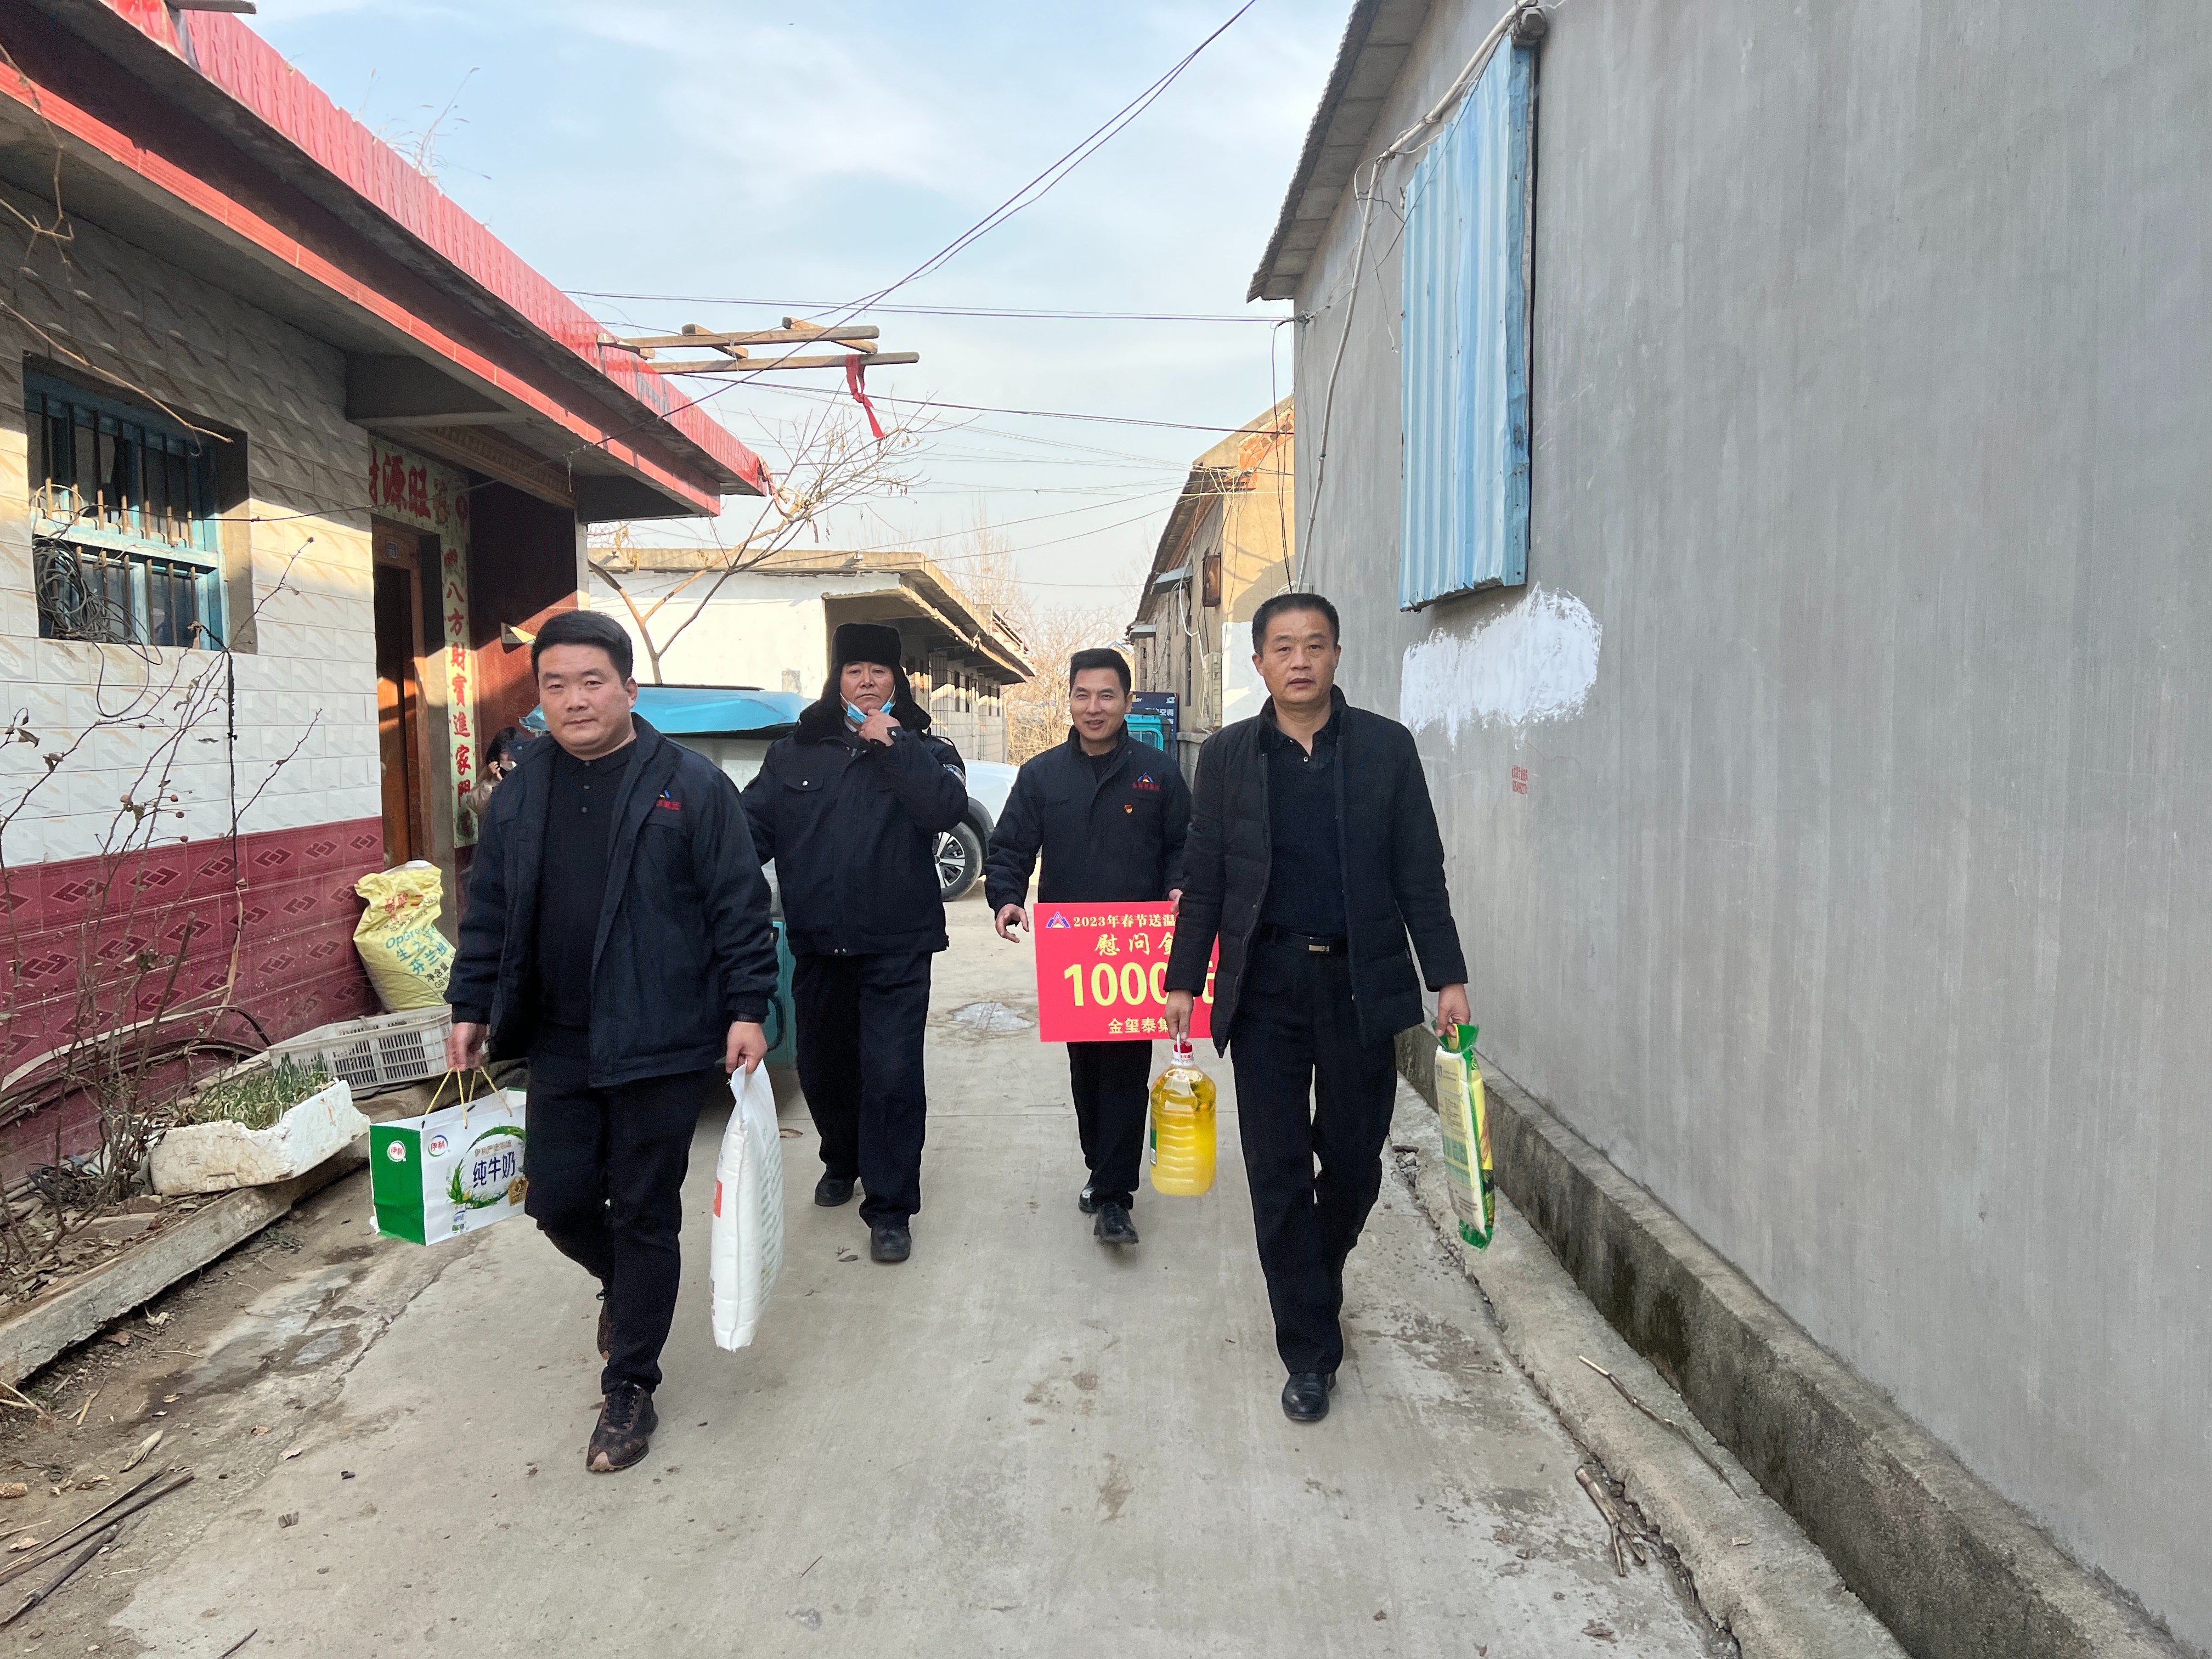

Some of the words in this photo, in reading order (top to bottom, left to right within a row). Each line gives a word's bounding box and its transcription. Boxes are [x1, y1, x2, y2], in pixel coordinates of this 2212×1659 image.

[425, 962, 449, 983] 净含量
[431, 1138, 445, 1152] 伊利
[473, 1151, 515, 1188] 纯牛奶
